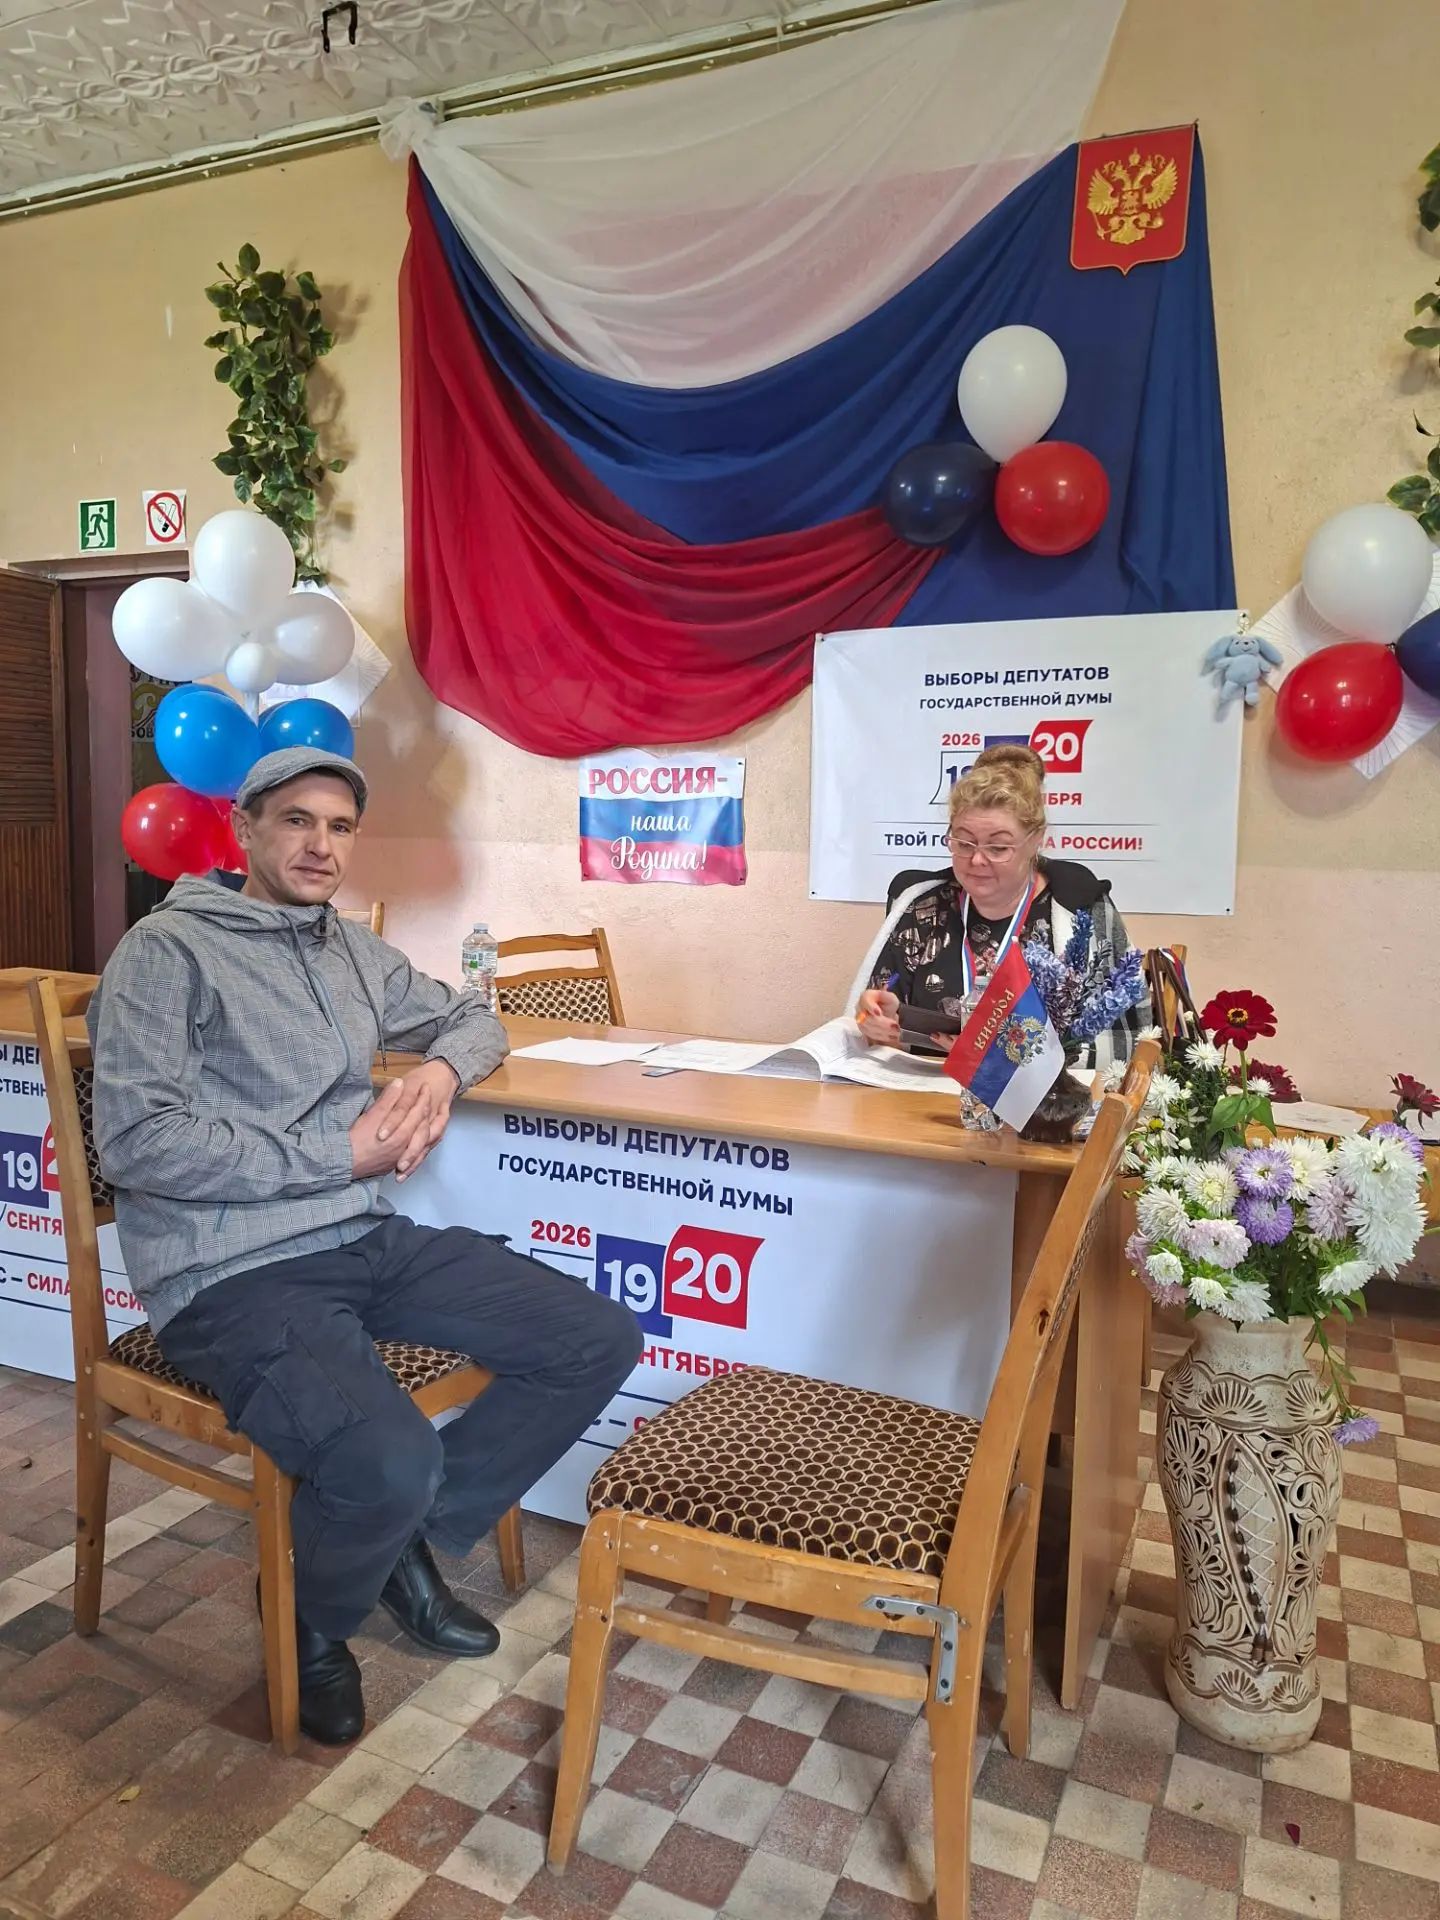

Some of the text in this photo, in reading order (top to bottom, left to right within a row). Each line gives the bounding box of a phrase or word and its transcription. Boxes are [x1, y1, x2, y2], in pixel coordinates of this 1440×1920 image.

[924, 666, 1110, 687] ВЫБОРЫ ДЕПУТАТОВ
[919, 691, 1113, 710] ГОСУДАРСТВЕННОЙ ДУМЫ
[941, 733, 981, 747] 2026
[1034, 731, 1080, 763] 20
[588, 766, 729, 796] РОССИЯ-
[945, 765, 973, 791] 1
[630, 815, 692, 832] наша
[884, 831, 928, 847] ТВОЙ
[1061, 836, 1143, 850] РОССИИ!
[610, 835, 708, 880] Родина!
[503, 1113, 791, 1172] ВЫБОРЫ ДЕПУТАТОВ
[2, 1150, 38, 1192] 19
[498, 1153, 794, 1216] ГОСУДАРСТВЕННОЙ ДУМЫ
[6, 1210, 63, 1237] СЕНТЯ
[530, 1219, 592, 1248] 2026
[603, 1259, 657, 1314] 19
[671, 1246, 742, 1304] 20
[637, 1344, 750, 1379] НТЯБР
